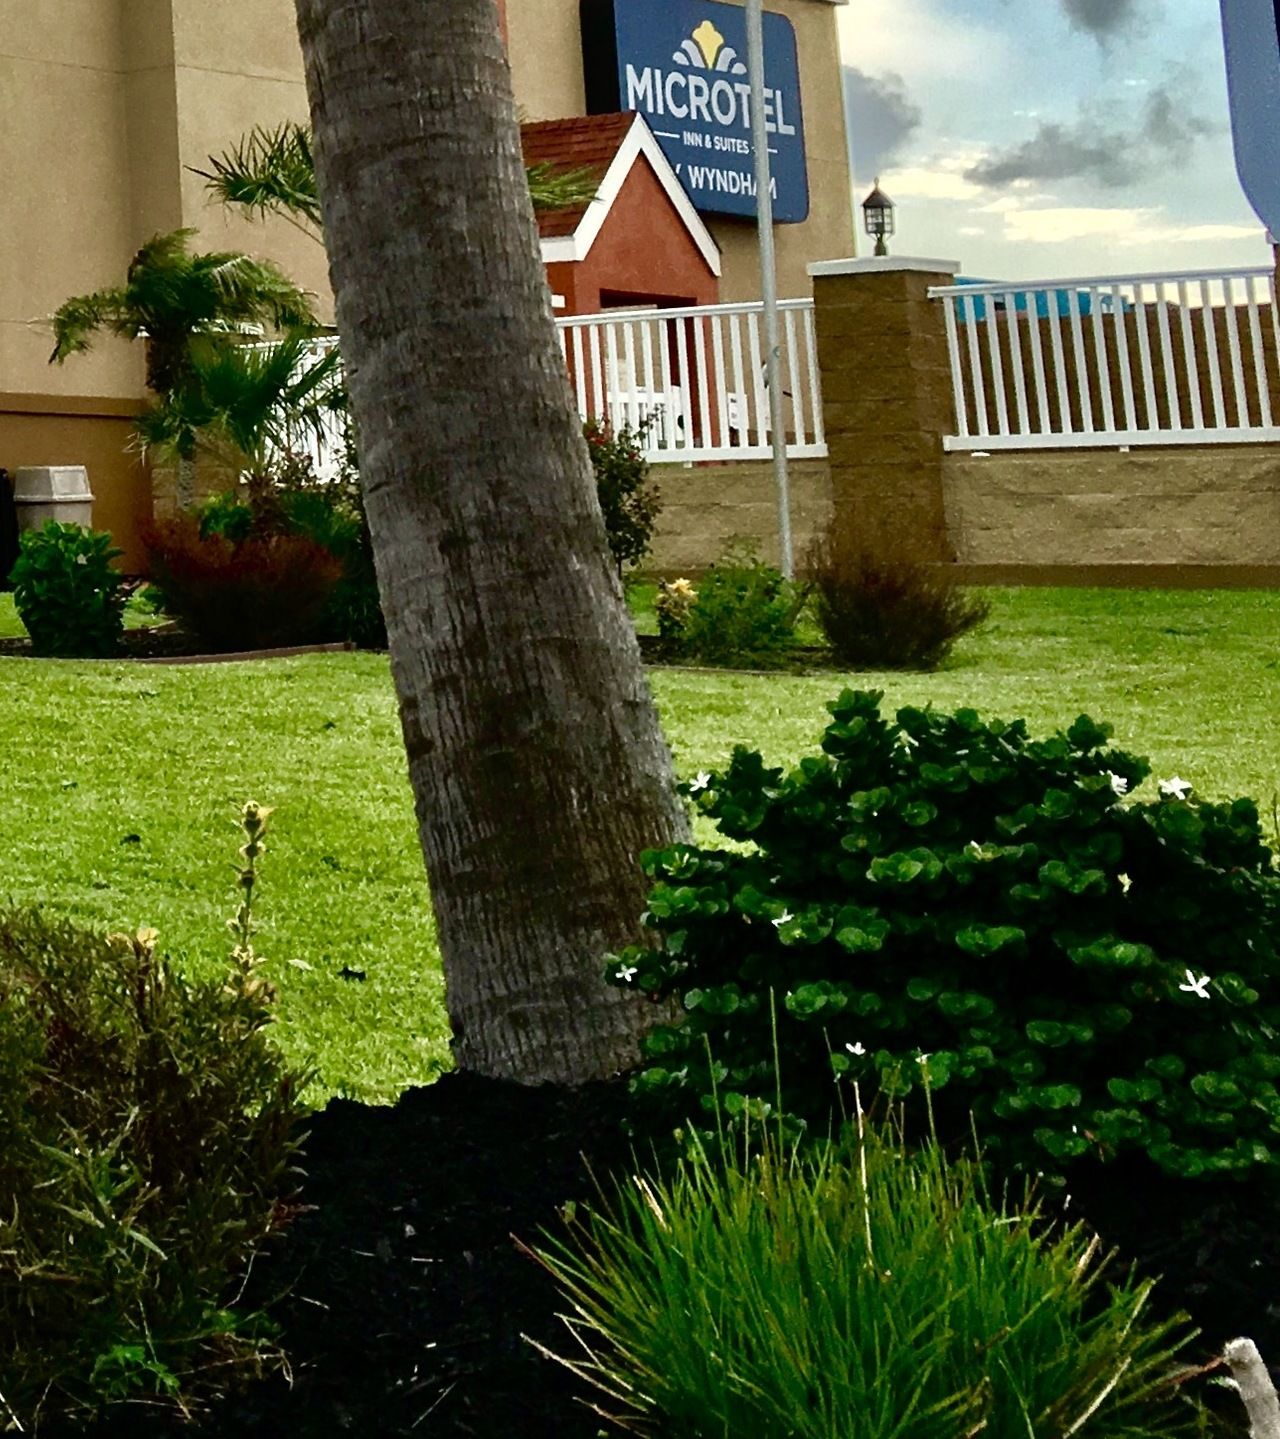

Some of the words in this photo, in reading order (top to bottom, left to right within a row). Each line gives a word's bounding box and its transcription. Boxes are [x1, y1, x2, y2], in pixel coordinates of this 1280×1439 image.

[626, 64, 796, 136] MICROTEL
[682, 130, 703, 148] INN
[704, 134, 713, 149] &
[714, 136, 750, 155] SUITES
[688, 165, 778, 200] WYNDHM
